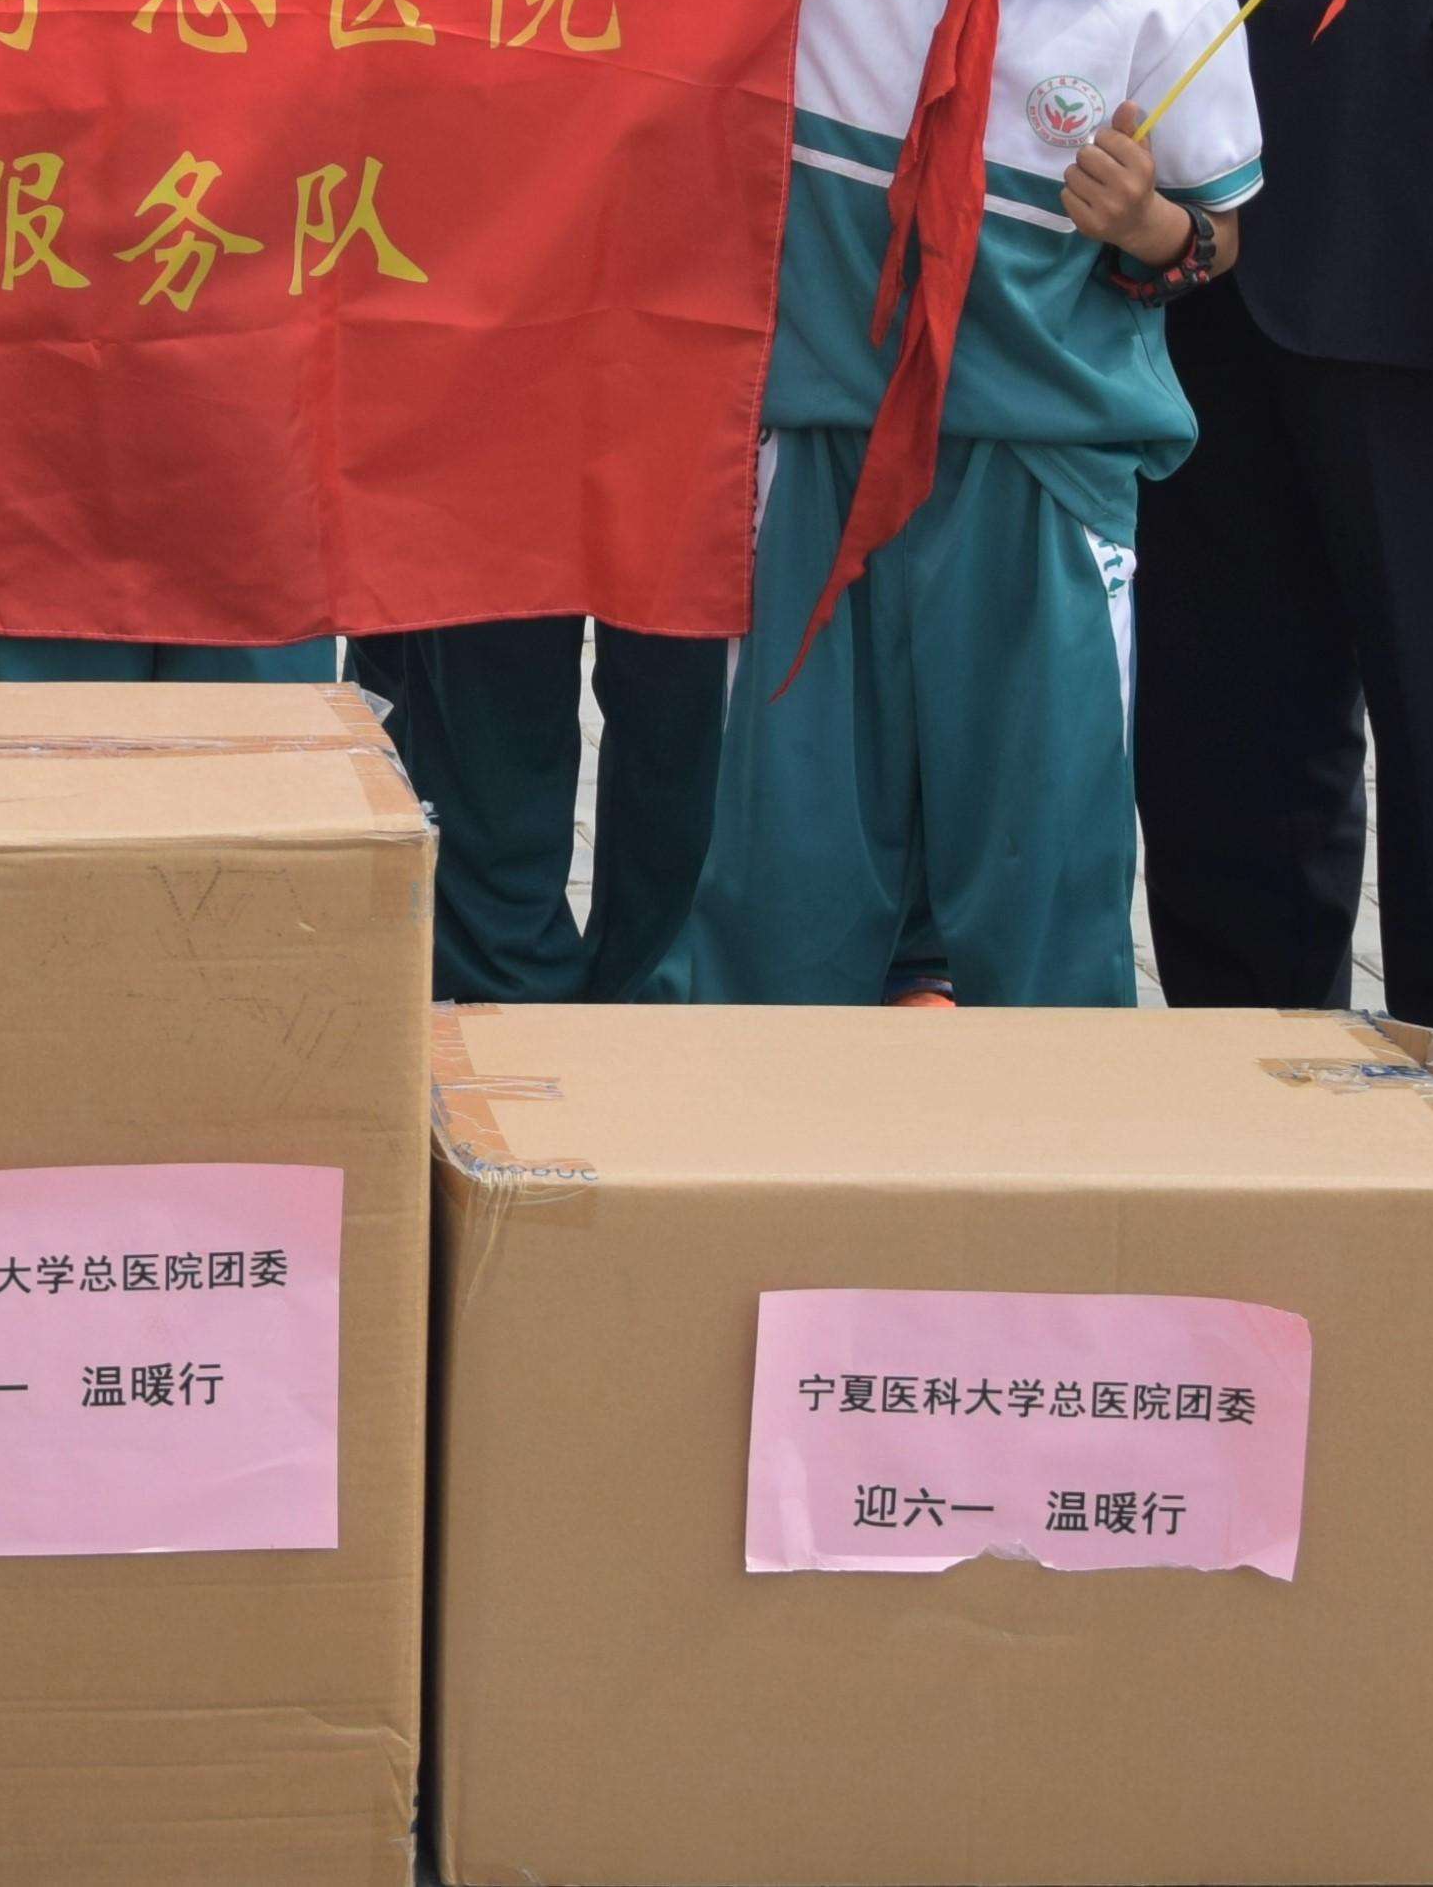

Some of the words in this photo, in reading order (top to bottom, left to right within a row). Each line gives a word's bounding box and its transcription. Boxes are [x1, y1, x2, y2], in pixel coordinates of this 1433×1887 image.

[81, 1361, 224, 1408] 温暖行
[798, 1373, 1256, 1426] 宁夏医科大学总医院团委
[853, 1484, 996, 1529] 迎六一
[1044, 1490, 1187, 1536] 温暖行
